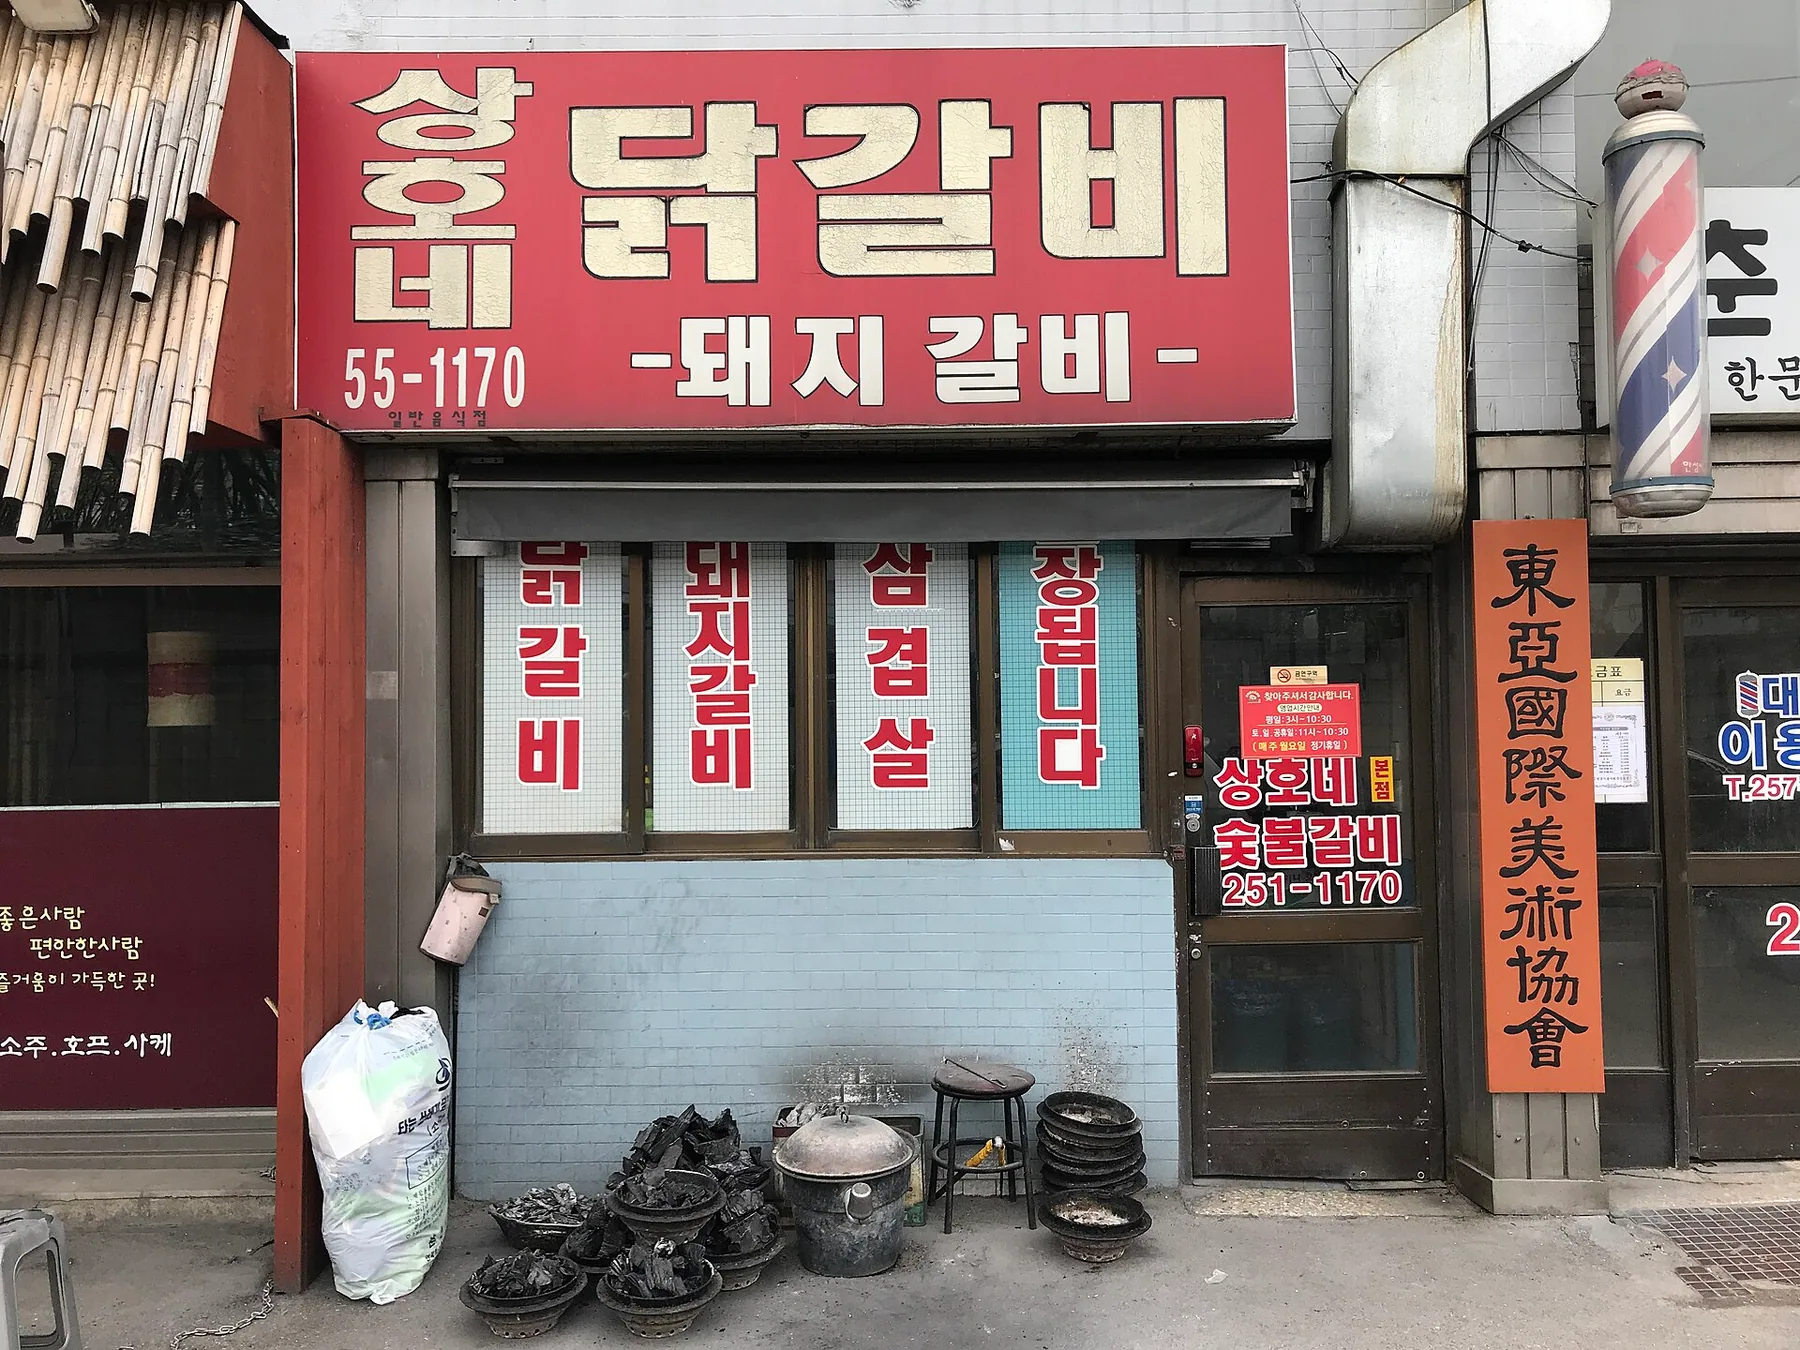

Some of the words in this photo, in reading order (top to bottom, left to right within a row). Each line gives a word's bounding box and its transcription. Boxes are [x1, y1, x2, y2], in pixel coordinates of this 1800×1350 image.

[351, 66, 534, 330] 상호네
[569, 96, 1230, 283] 닭갈비
[344, 346, 526, 409] 55-1170
[388, 410, 487, 428] 일반음식점
[517, 541, 590, 792] 닭갈비
[860, 542, 936, 791] 삼겹살
[1591, 665, 1623, 678] 금표
[1615, 688, 1632, 697] 요금
[1280, 741, 1306, 751] 월요일
[1213, 757, 1358, 811] 상호네
[1374, 759, 1391, 800] 본점
[1491, 543, 1589, 1069] 東亞國際美術協會
[1213, 814, 1402, 870] 숯불갈비
[1221, 870, 1403, 906] 251-1170
[29, 936, 143, 960] 편안한사람
[1766, 902, 1800, 956] 2
[71, 972, 126, 992] 가득한
[132, 972, 156, 991] 곳!
